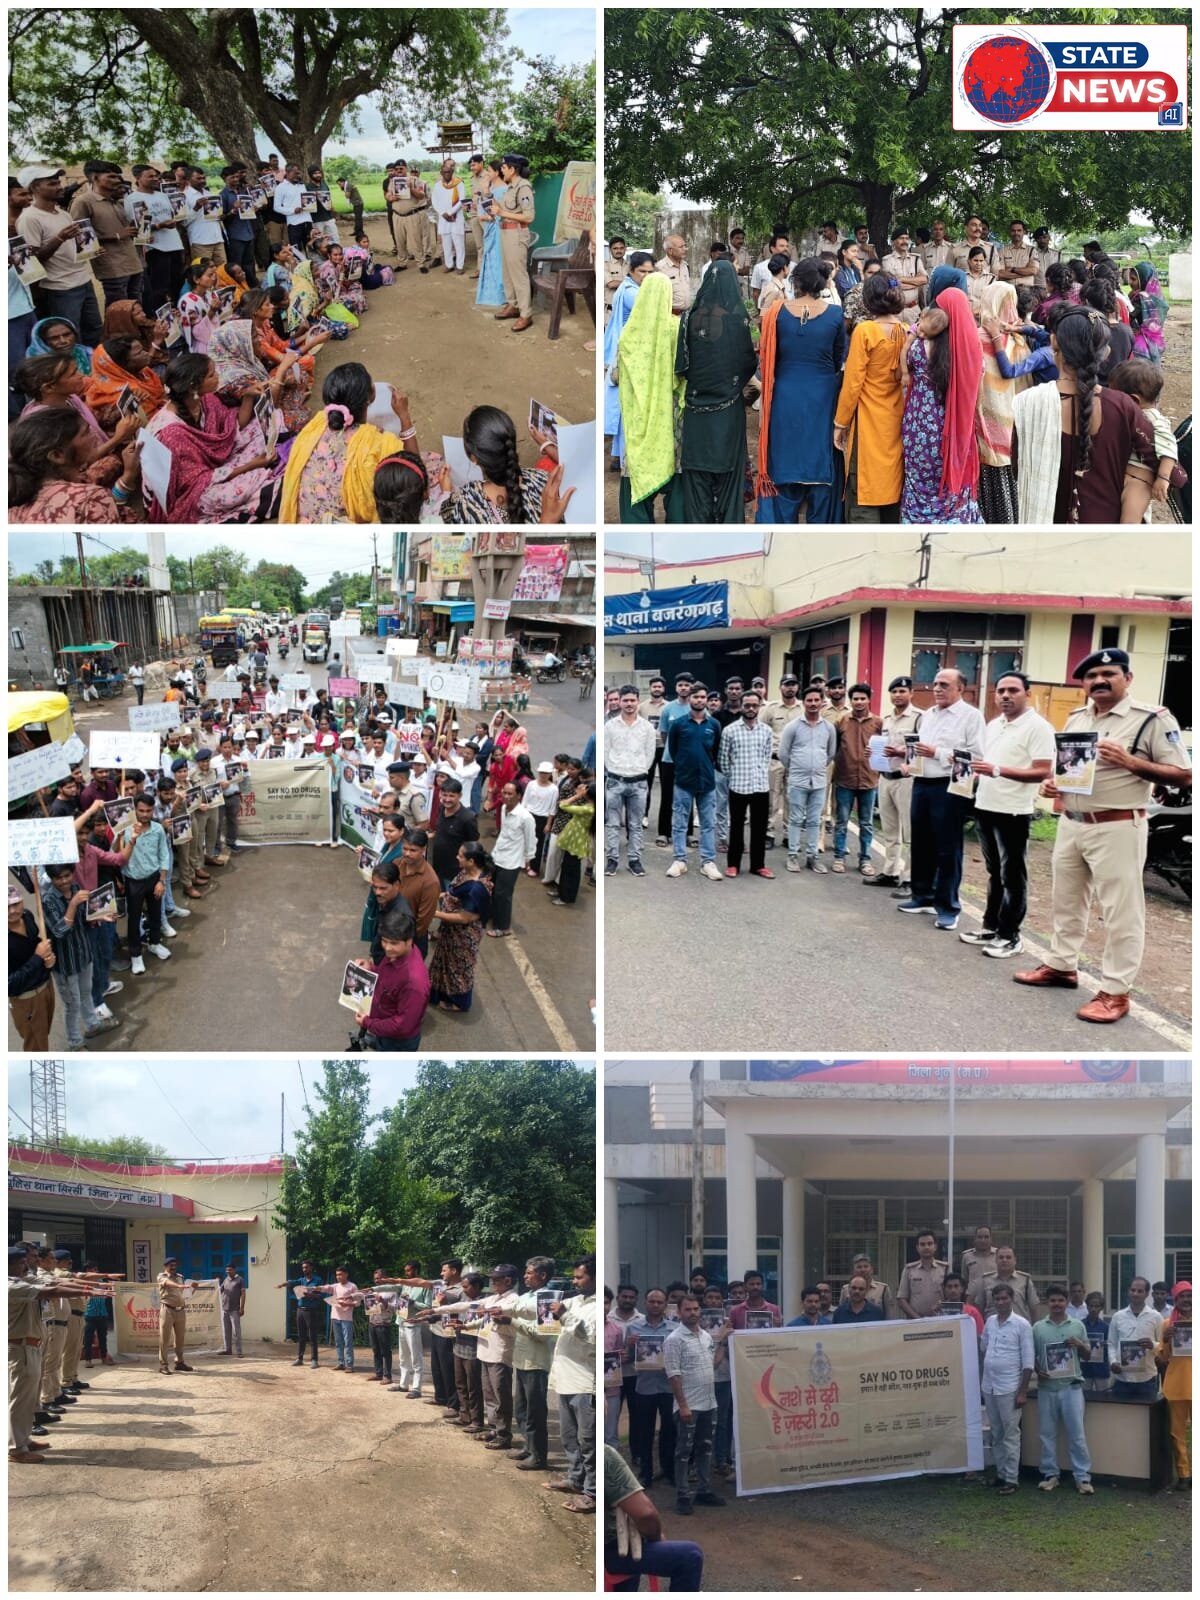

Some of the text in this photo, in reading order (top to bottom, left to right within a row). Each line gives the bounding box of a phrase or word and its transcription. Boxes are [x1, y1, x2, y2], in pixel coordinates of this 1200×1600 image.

[616, 610, 649, 626] थाना
[652, 600, 724, 622] बजरंगगढ़
[860, 1367, 949, 1384] SAY NO TO DRUGS
[779, 1382, 839, 1411] नशे से दूरी
[772, 1410, 781, 1435] है
[821, 1411, 840, 1428] 2.0
